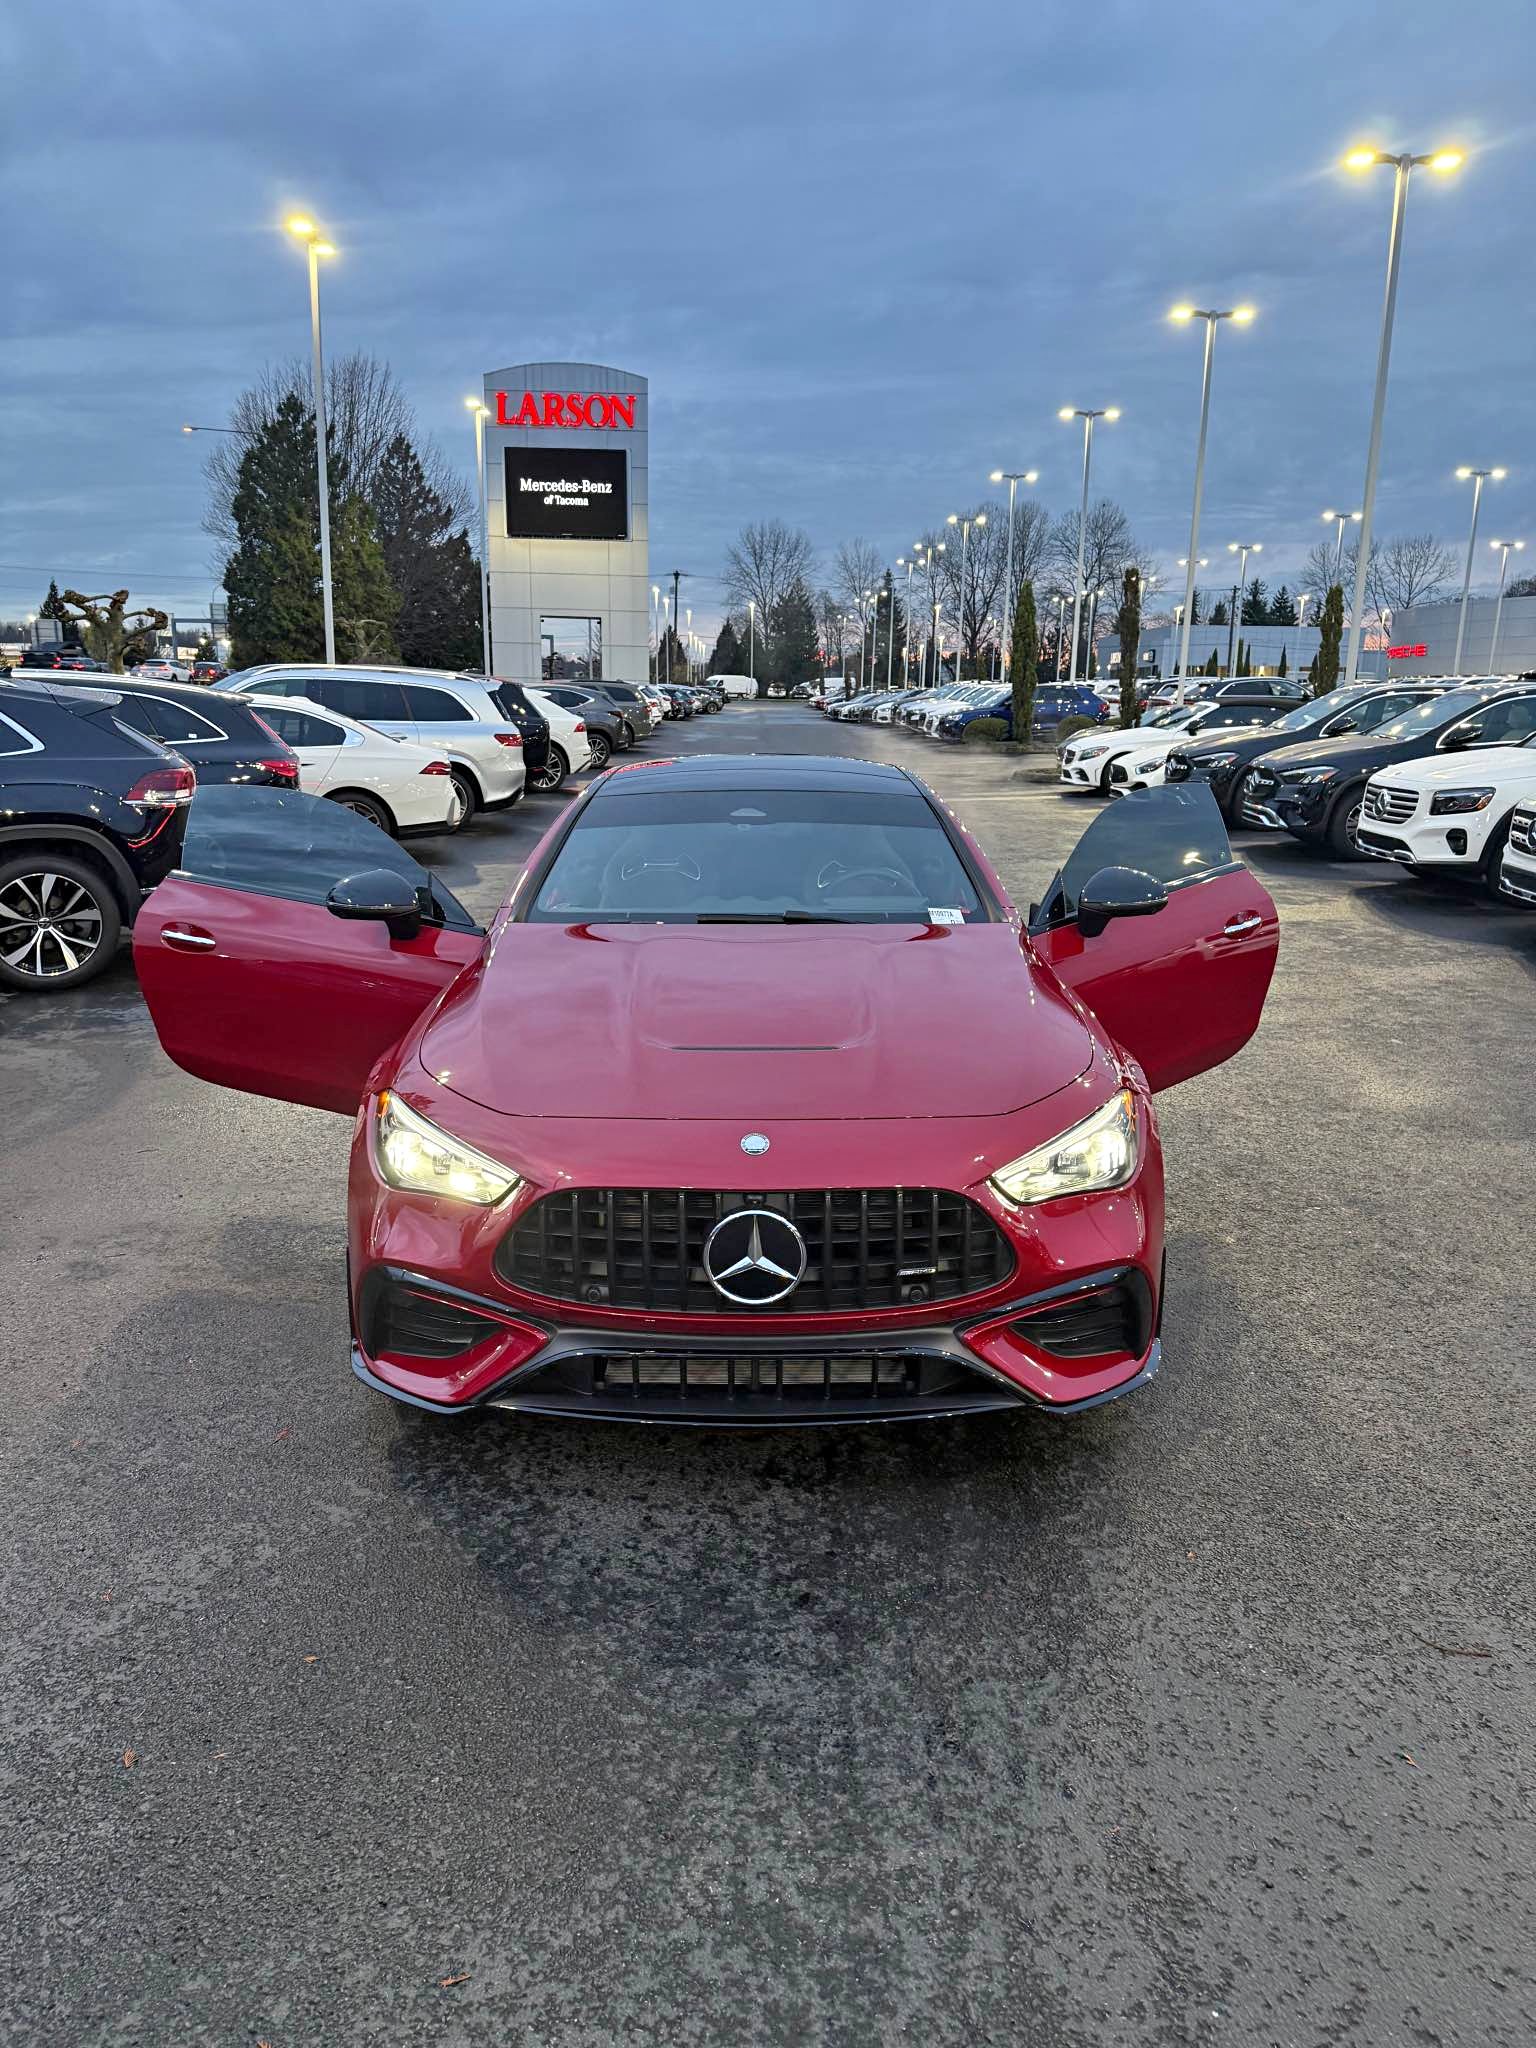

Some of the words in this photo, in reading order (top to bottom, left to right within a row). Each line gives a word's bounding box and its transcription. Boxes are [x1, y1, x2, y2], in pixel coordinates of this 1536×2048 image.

[496, 393, 636, 427] LARSON
[520, 478, 612, 493] Mercedes-Benz
[544, 496, 554, 505] of
[555, 496, 588, 506] Tacoma
